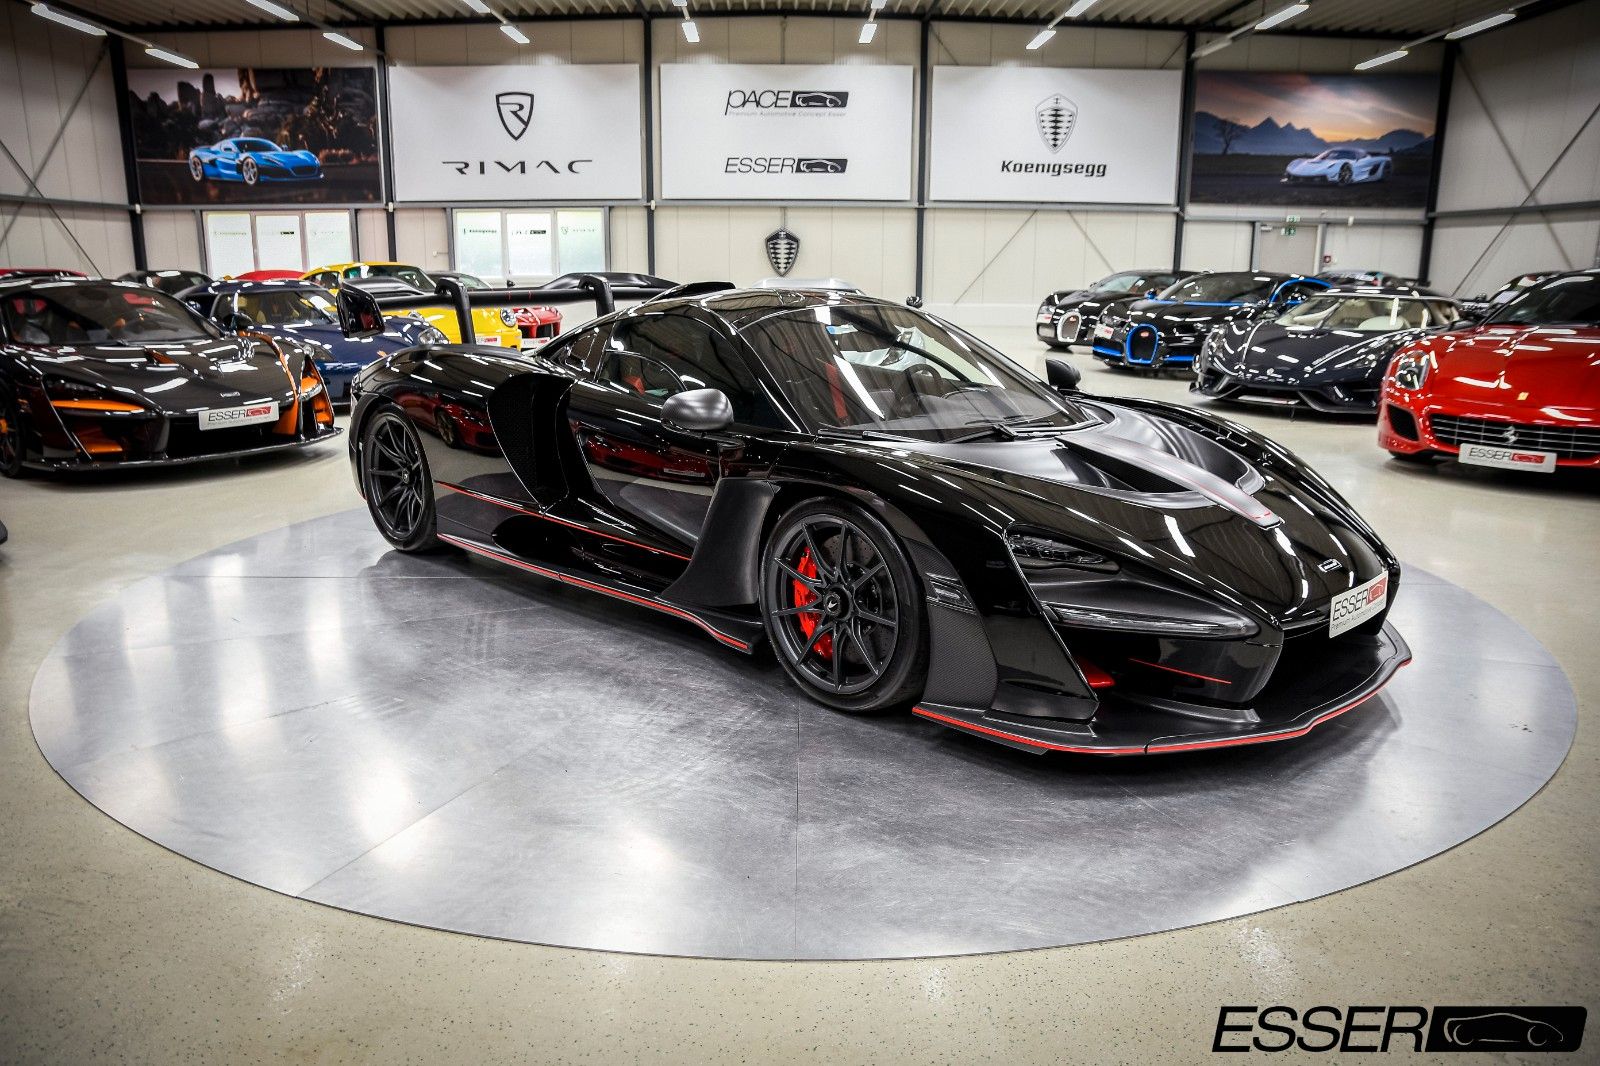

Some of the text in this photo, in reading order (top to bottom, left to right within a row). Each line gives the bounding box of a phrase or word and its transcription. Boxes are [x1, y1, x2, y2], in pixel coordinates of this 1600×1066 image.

[441, 160, 593, 175] RIMAC
[724, 157, 796, 173] ESSER
[1001, 160, 1107, 177] Koenigsegg
[208, 409, 246, 421] ESSER
[1469, 447, 1511, 461] ESSER
[1333, 588, 1368, 621] ESSER
